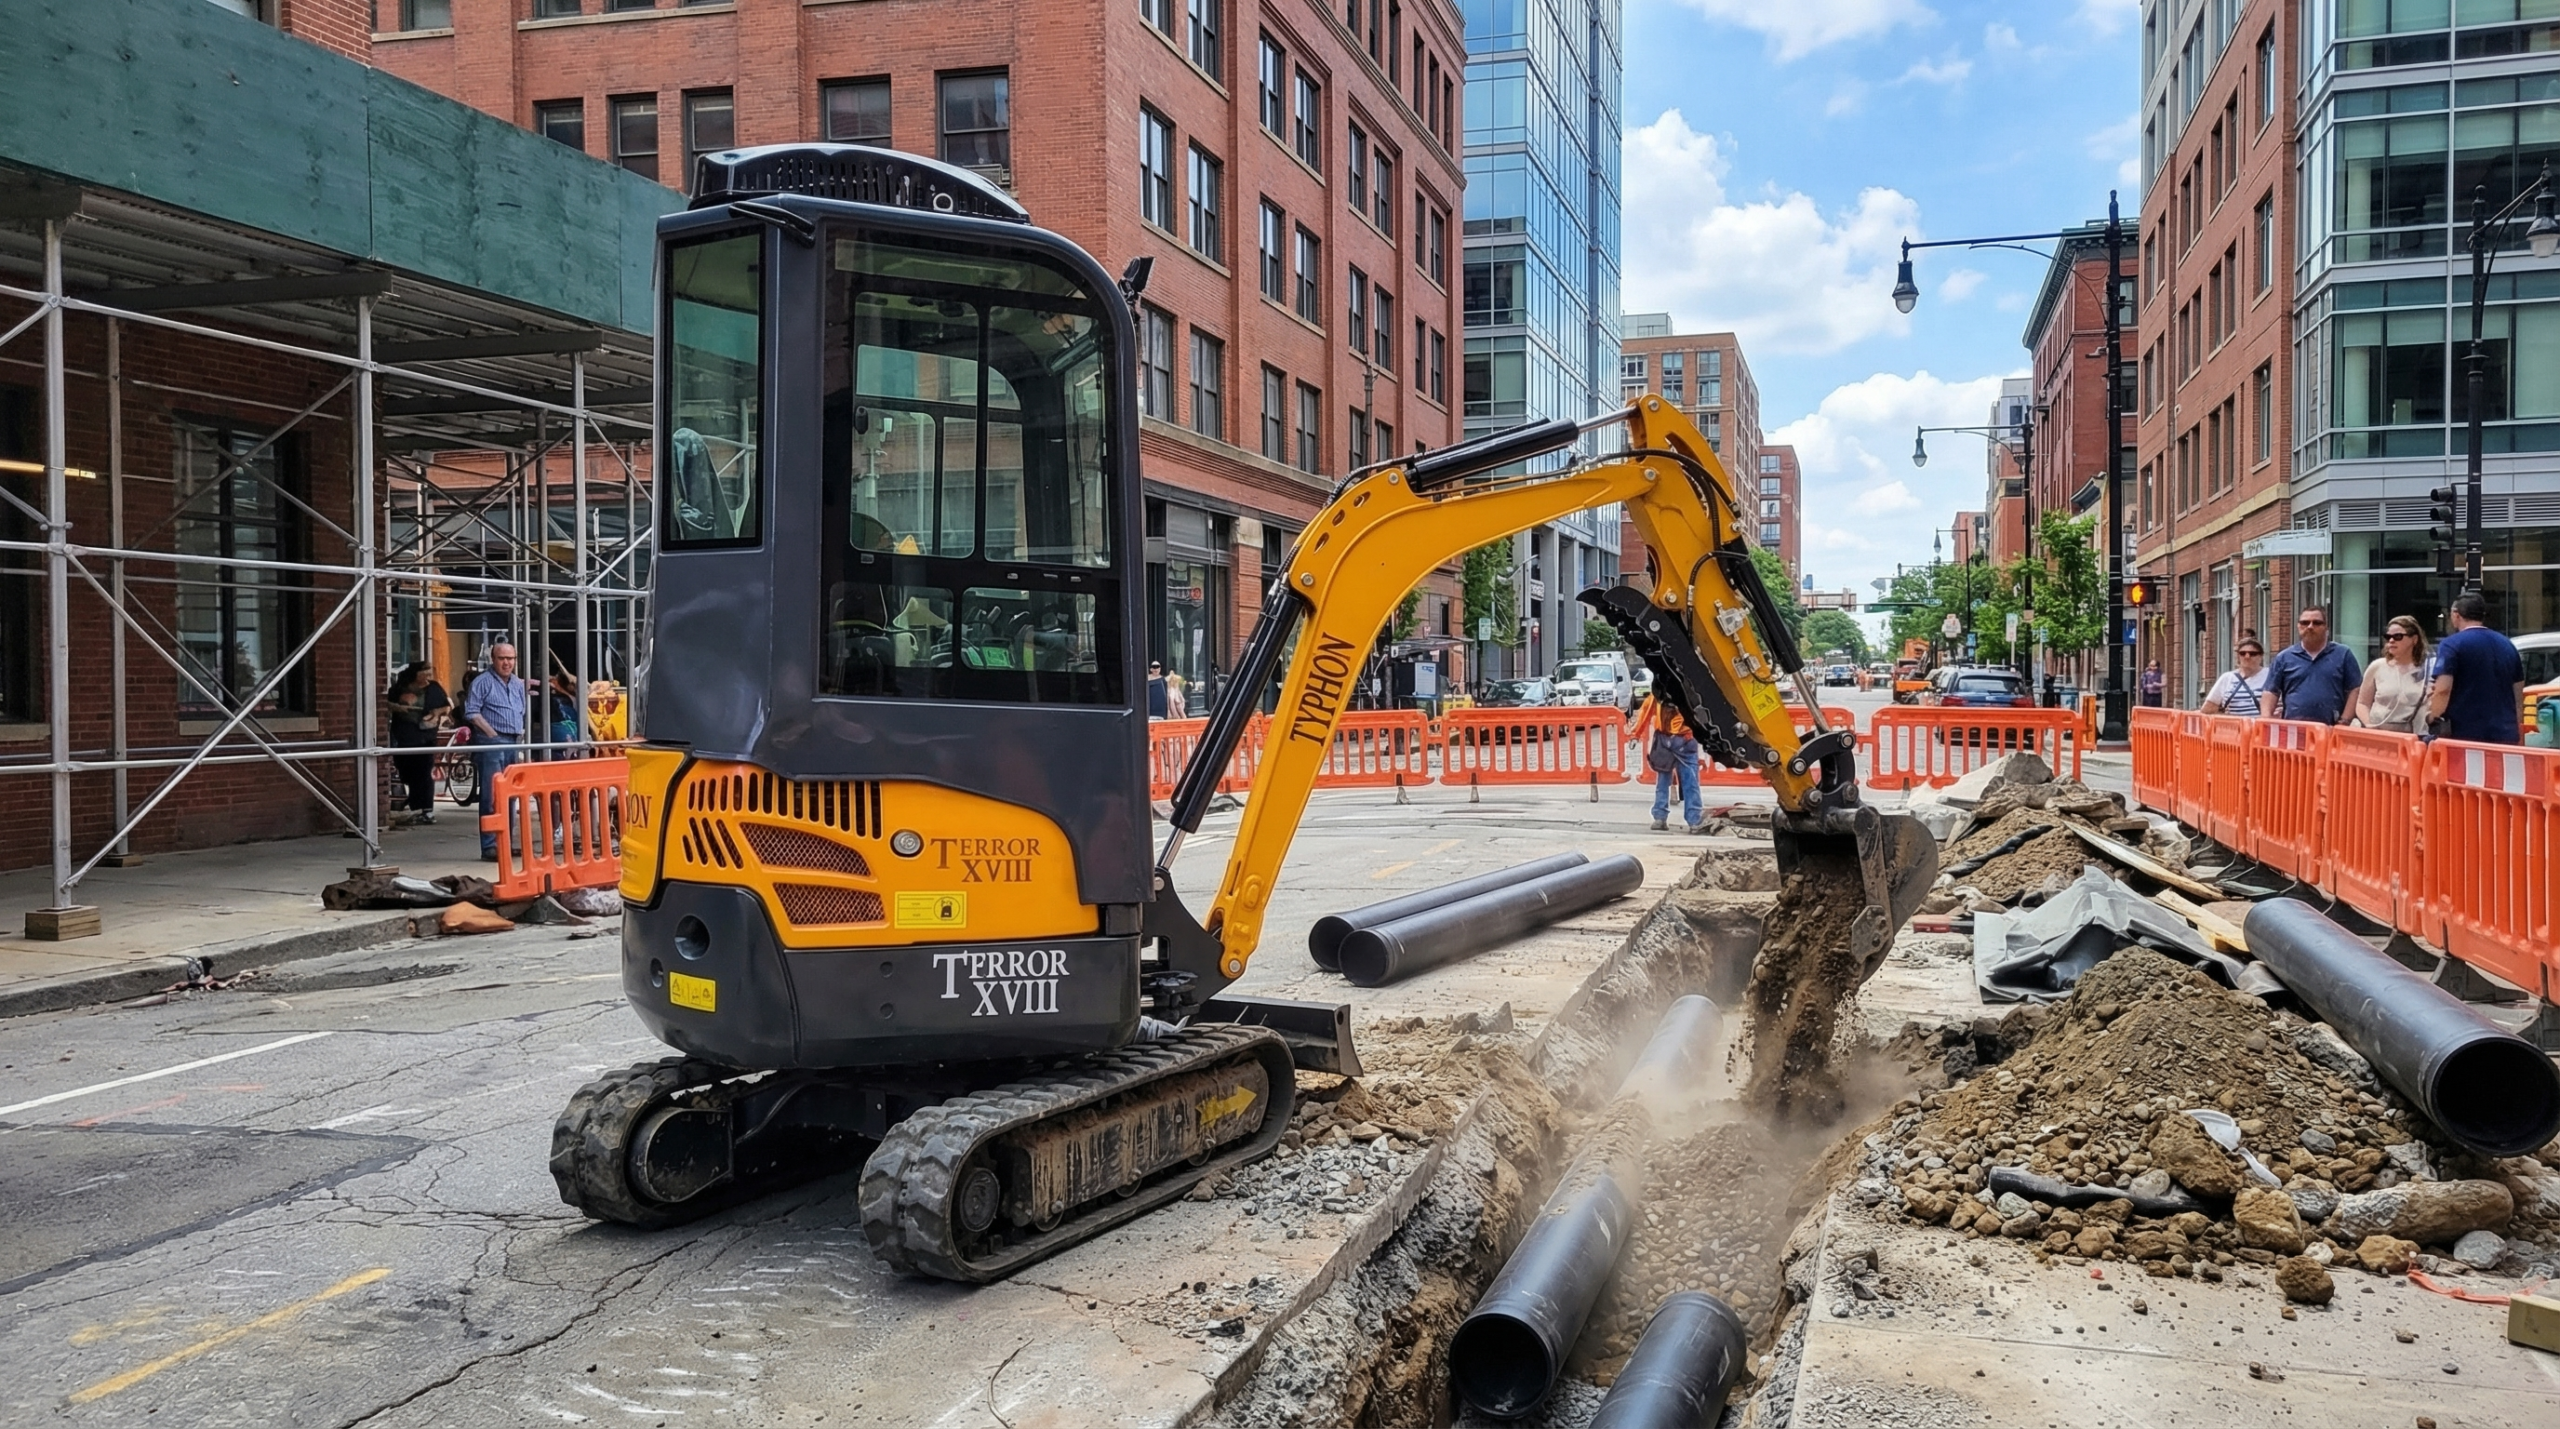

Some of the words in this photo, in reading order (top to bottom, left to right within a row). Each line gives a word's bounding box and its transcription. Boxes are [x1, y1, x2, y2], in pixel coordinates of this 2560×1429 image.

[1289, 632, 1356, 747] TYPHON
[930, 838, 1041, 870] TERROR
[961, 858, 1032, 883] XVIII
[971, 978, 1060, 1017] XVIII
